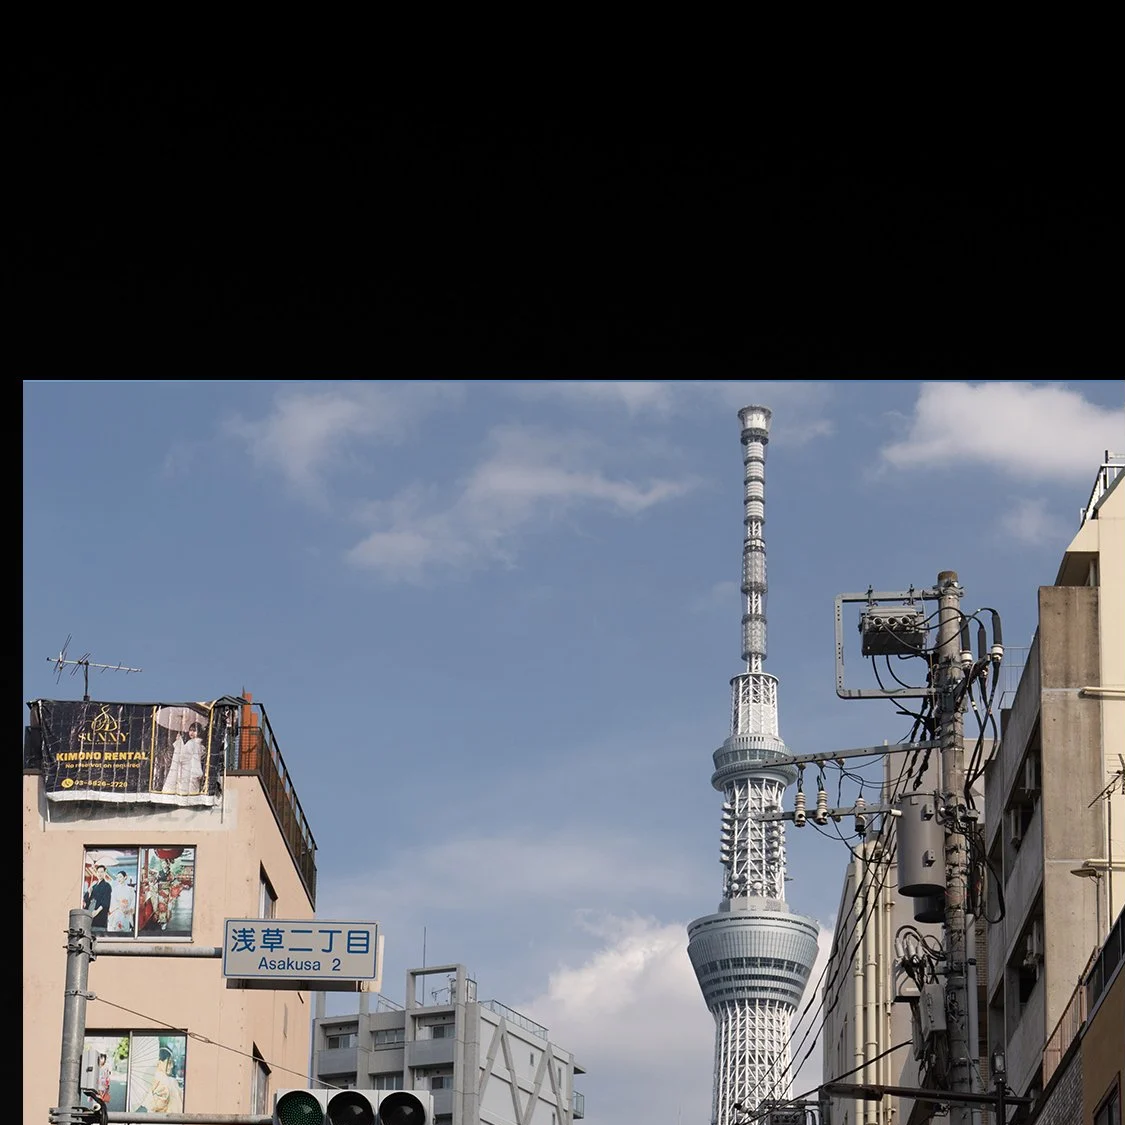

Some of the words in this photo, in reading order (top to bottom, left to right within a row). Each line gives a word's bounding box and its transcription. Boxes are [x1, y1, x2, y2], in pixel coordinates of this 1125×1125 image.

[78, 732, 129, 742] SUNNY
[56, 752, 102, 761] KIMONO
[103, 752, 148, 760] RENTAL
[231, 928, 370, 954] 浅草二丁目
[258, 956, 320, 970] Asakusa
[332, 958, 341, 971] 2
